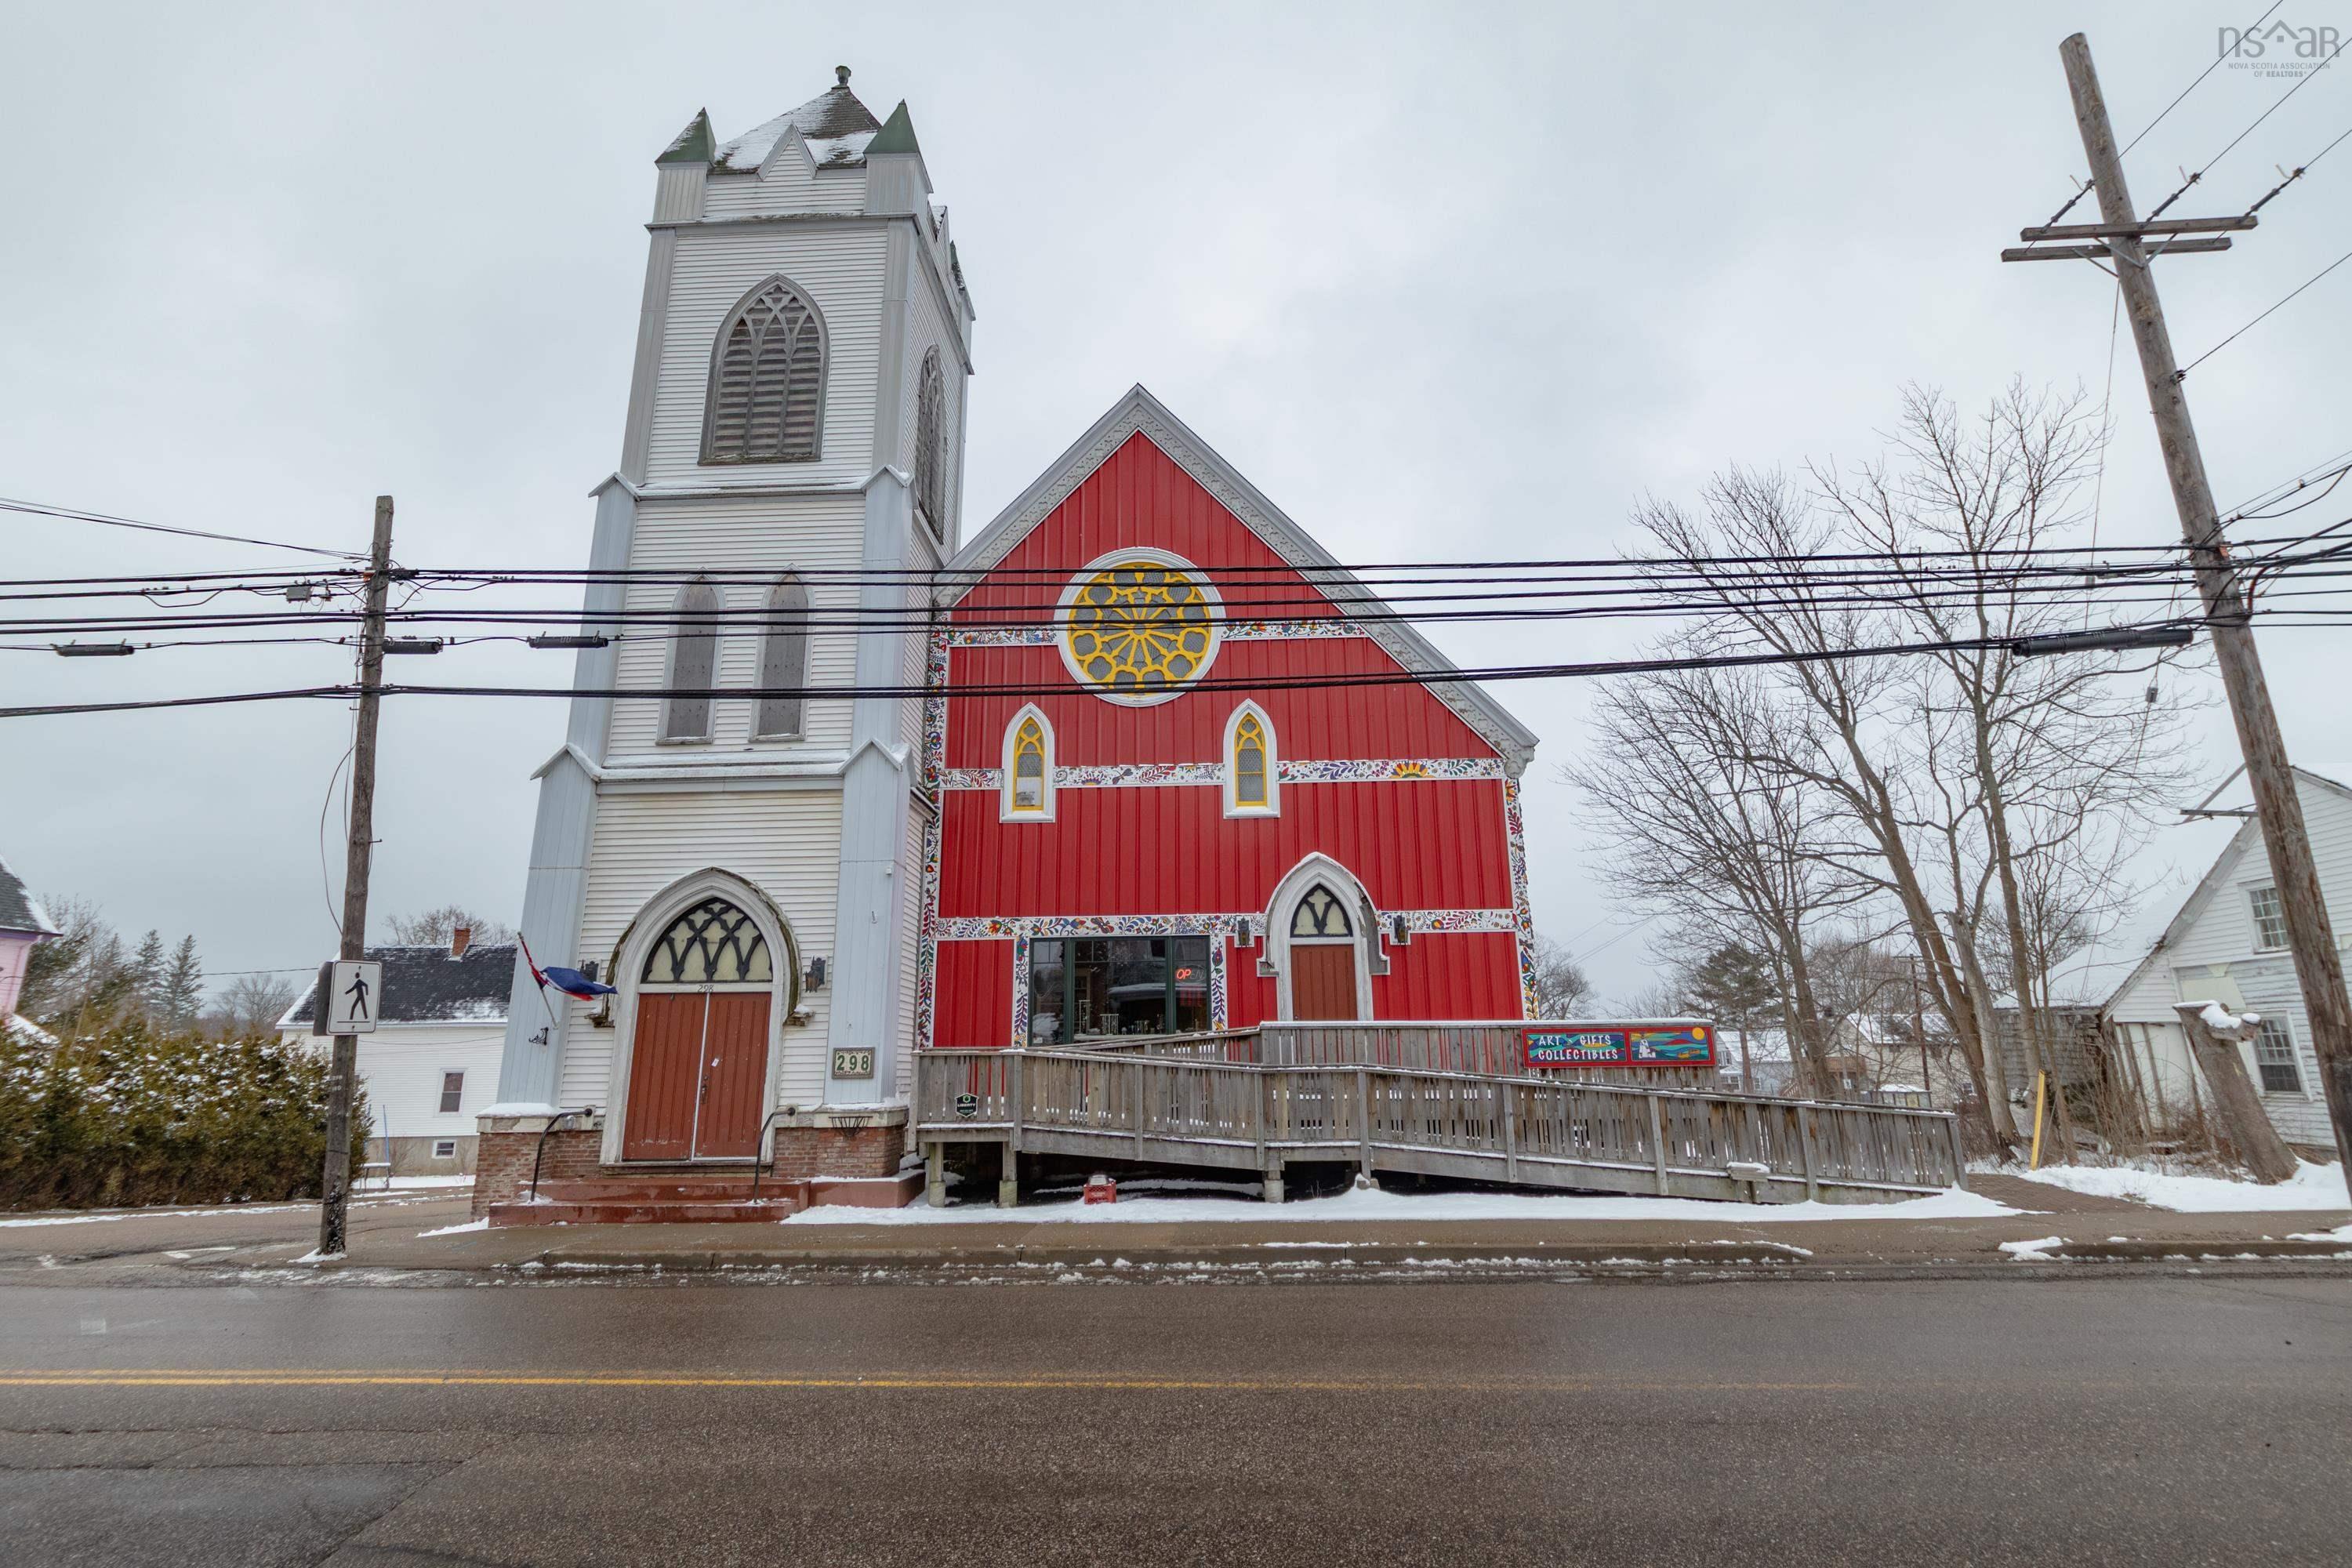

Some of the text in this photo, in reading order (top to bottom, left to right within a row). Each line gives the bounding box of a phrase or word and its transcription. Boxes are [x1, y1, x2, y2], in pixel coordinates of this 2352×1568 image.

[1176, 968, 1203, 980] OPEN
[697, 984, 713, 993] 298
[1539, 1036, 1562, 1046] ART
[1580, 1035, 1611, 1045] GIFTS
[1538, 1050, 1618, 1061] COLLECTIBLES
[837, 1054, 869, 1071] 298
